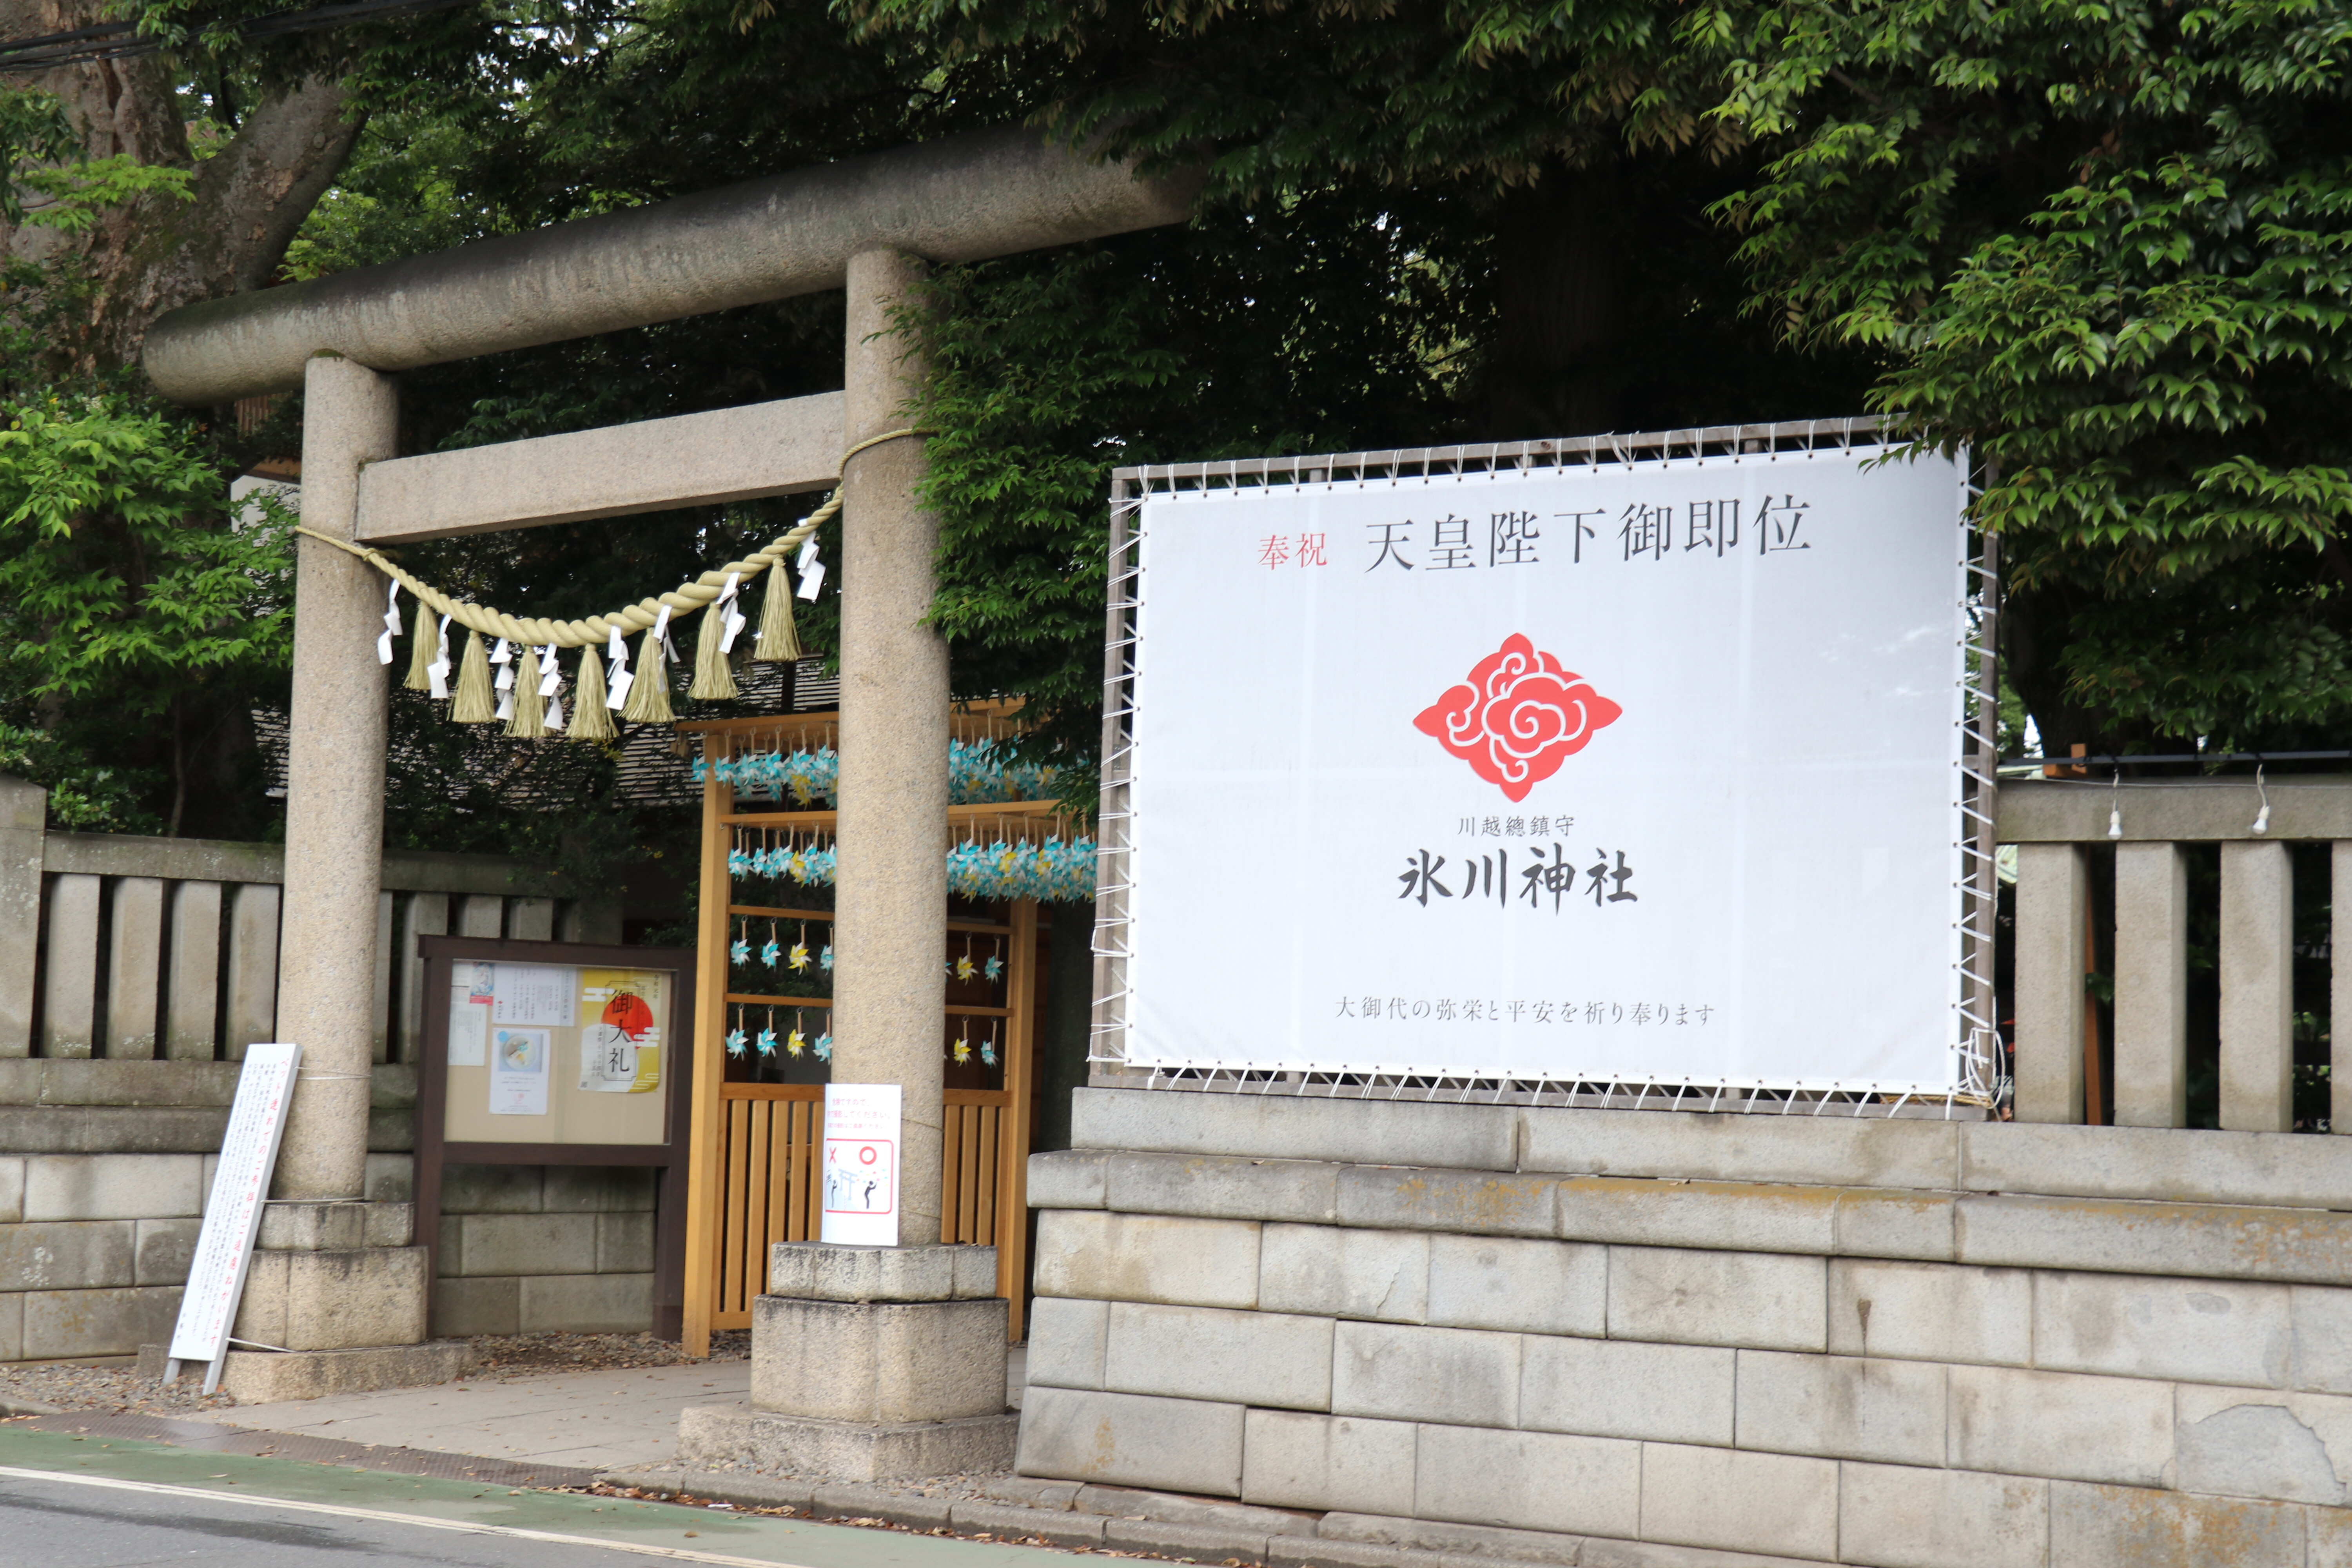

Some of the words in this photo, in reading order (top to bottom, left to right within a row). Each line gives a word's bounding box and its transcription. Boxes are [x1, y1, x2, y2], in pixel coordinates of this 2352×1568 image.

[1259, 533, 1328, 570] 奉祝
[1365, 494, 1812, 573] 天皇陛下御即位
[1458, 814, 1575, 837] 川越總鎮守
[1397, 842, 1639, 915] 氷川神社
[608, 989, 633, 1073] 御大礼
[1335, 996, 1715, 1026] 大御代の弥栄と平安を祈り奉ります
